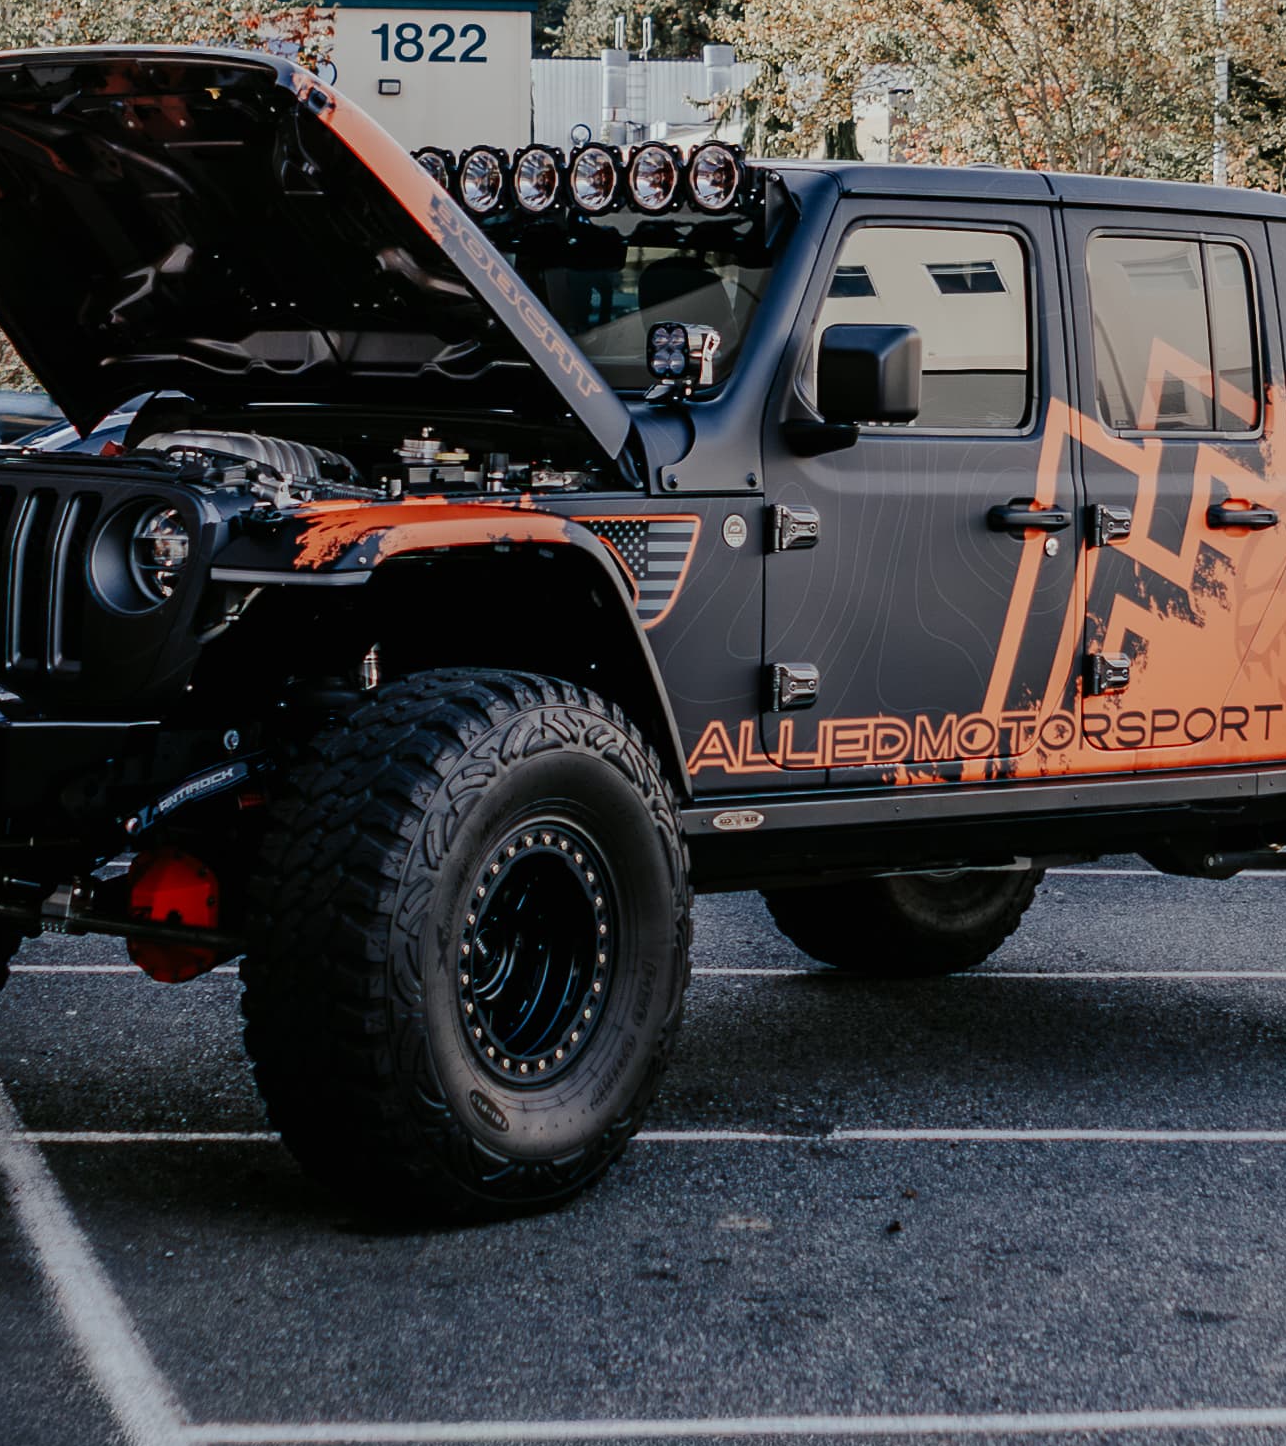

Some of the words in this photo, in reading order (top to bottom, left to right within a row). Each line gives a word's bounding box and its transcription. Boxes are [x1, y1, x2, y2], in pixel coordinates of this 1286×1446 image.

[371, 22, 487, 63] 1822
[430, 194, 603, 397] BOBCAT
[158, 767, 234, 812] ANTIROCK
